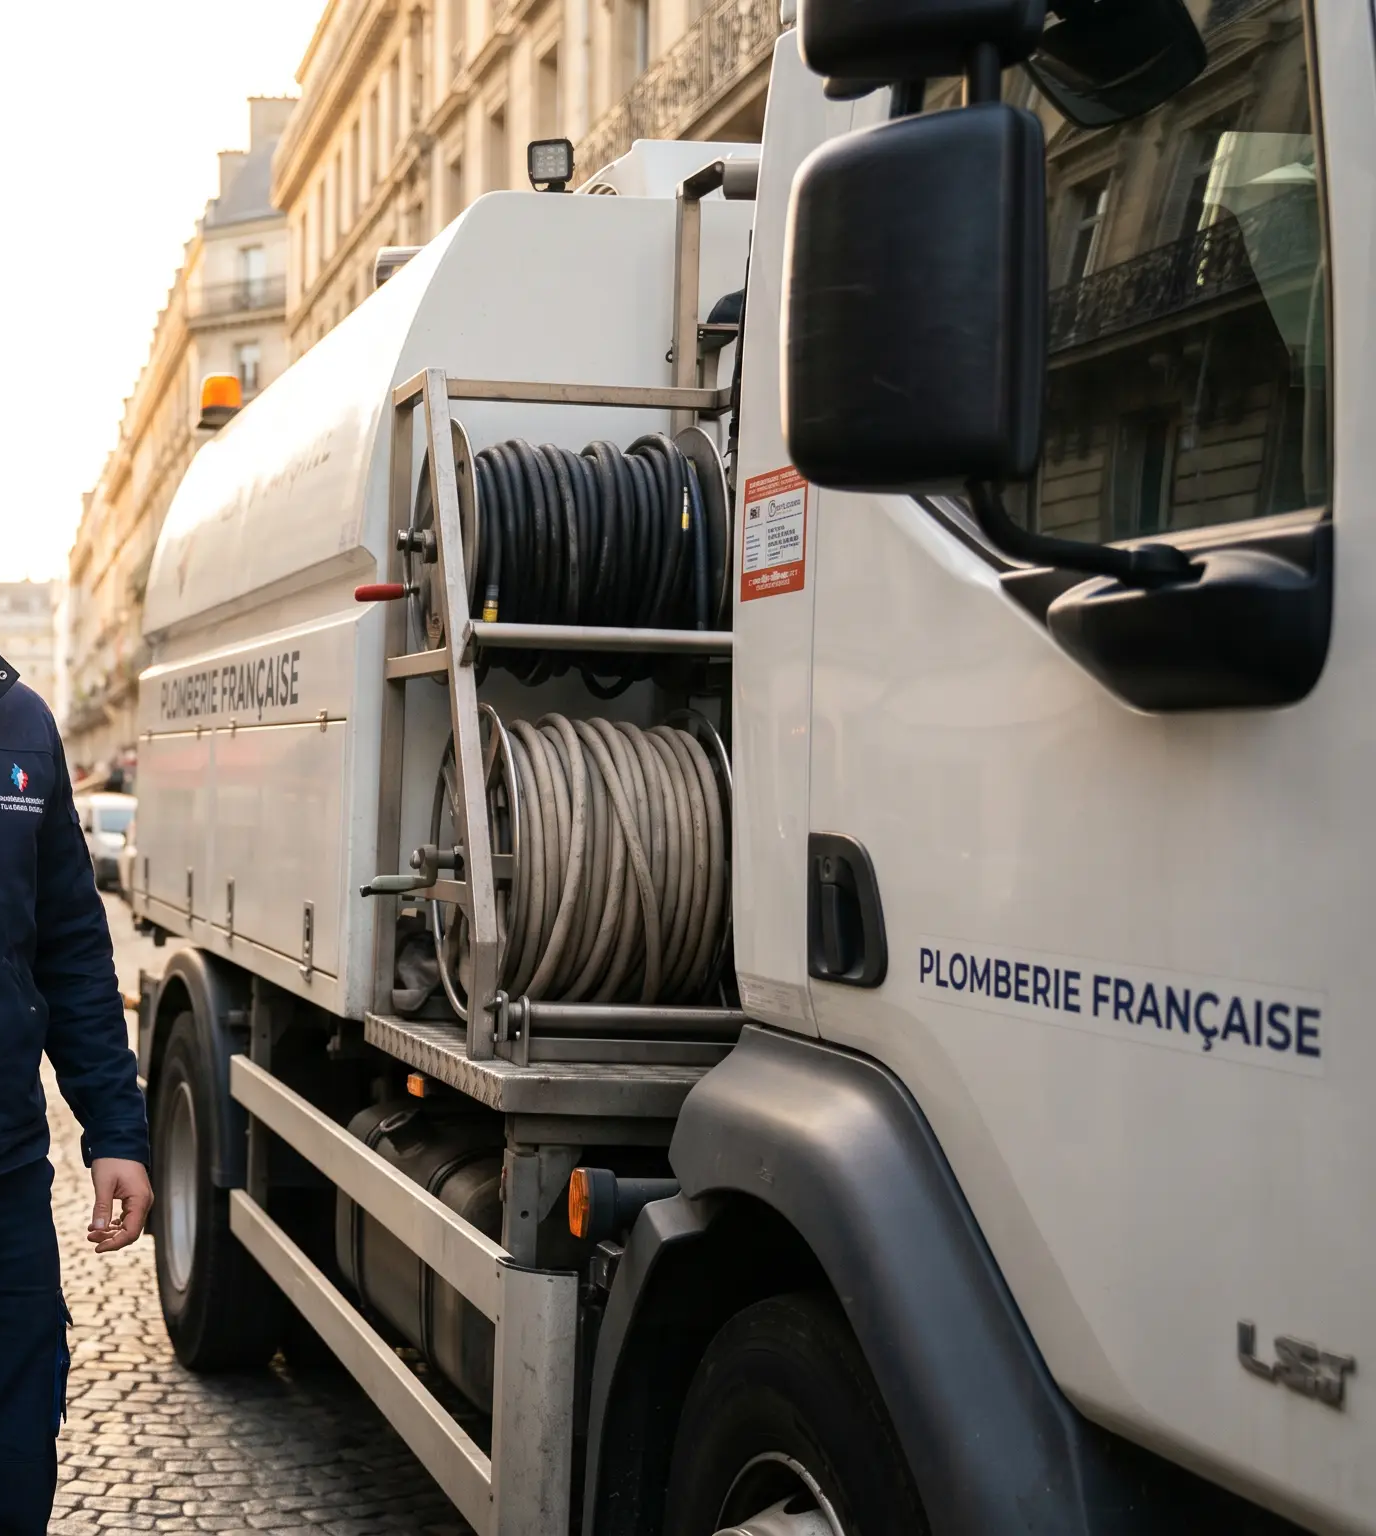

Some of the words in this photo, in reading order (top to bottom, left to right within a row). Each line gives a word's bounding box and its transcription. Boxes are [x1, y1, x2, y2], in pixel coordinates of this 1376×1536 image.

[161, 668, 218, 720] PLOMBERIE
[222, 650, 300, 721] FRANÇAISE
[920, 947, 1081, 1013] PLOMBERIE
[1093, 974, 1321, 1058] FRANÇAISE
